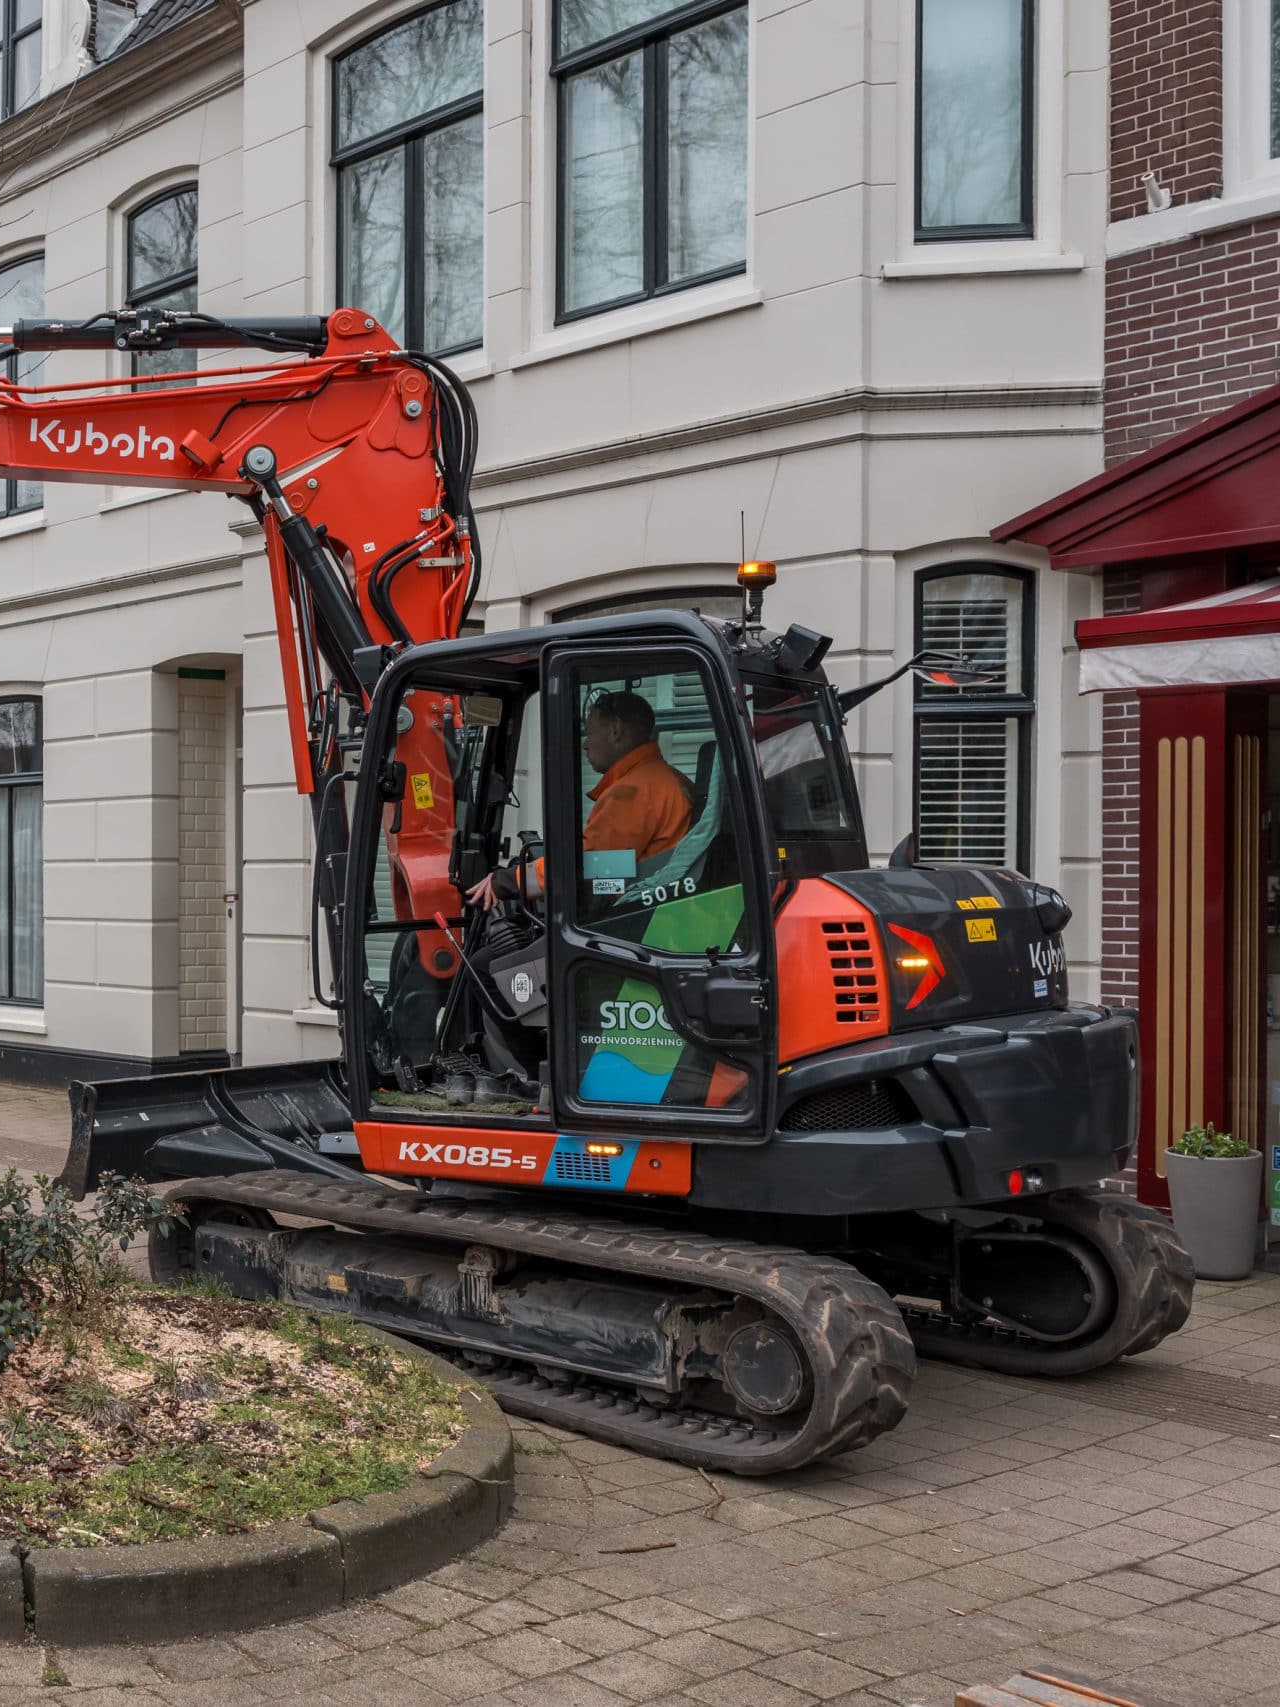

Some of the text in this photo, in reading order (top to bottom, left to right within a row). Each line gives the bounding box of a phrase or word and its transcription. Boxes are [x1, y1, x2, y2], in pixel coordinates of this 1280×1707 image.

[30, 417, 174, 460] Kubota
[641, 877, 696, 906] 5078
[580, 1035, 684, 1047] GROENVOORZIENING
[399, 1141, 537, 1170] KX085-5
